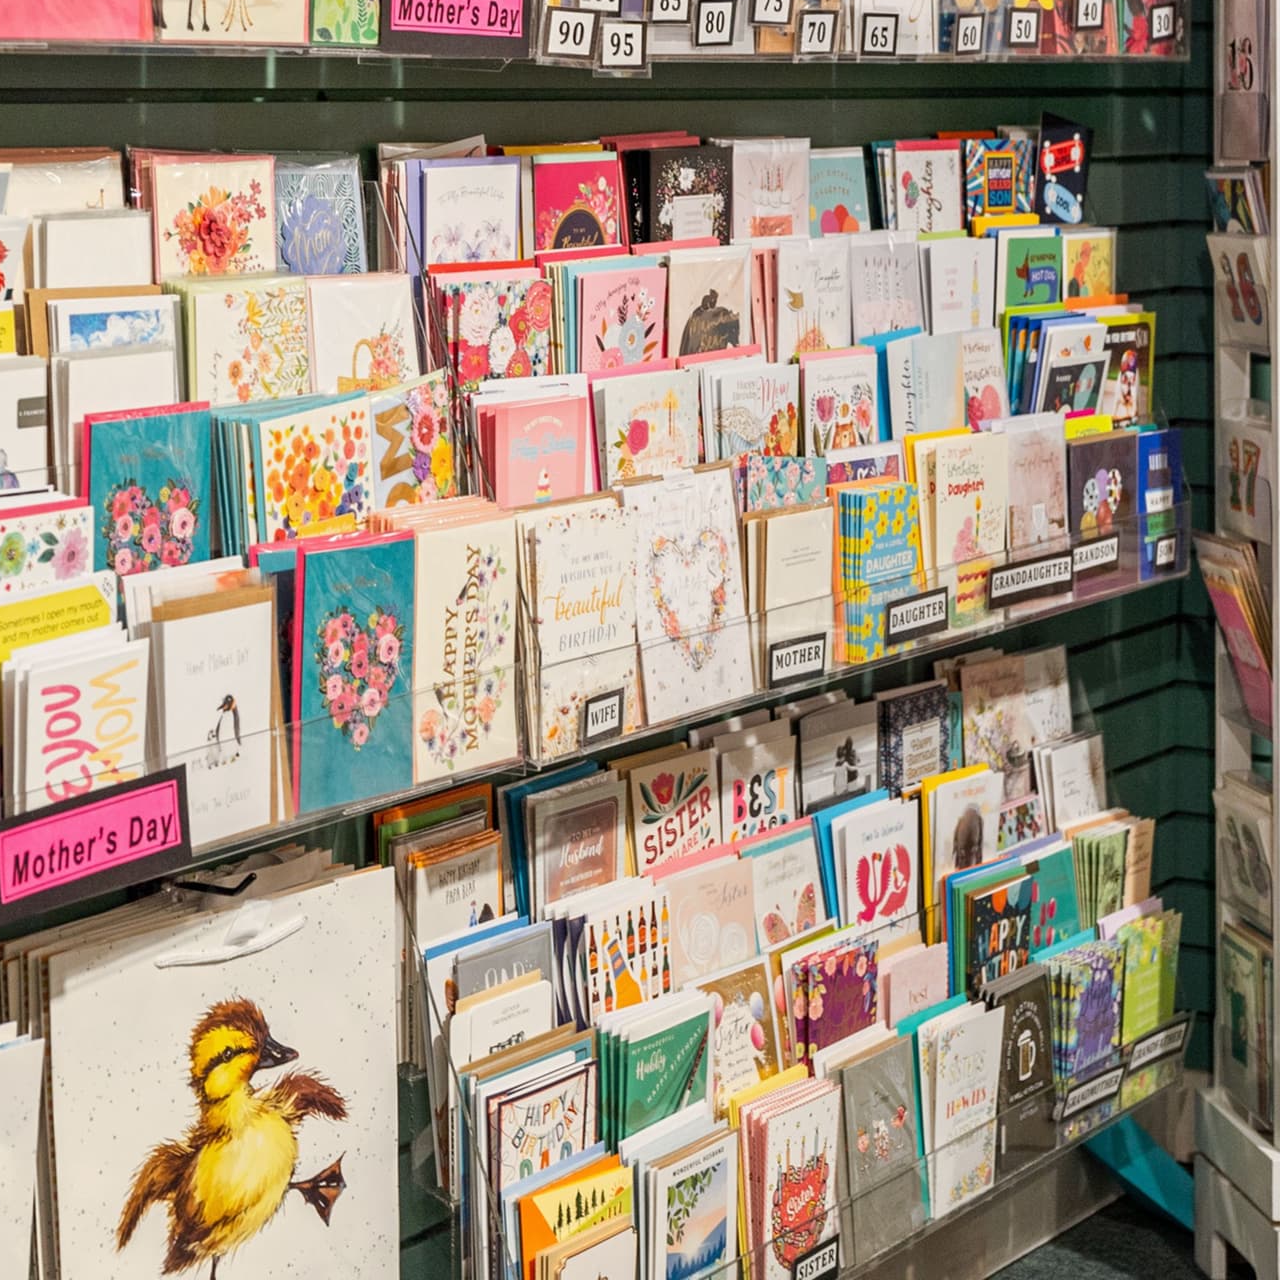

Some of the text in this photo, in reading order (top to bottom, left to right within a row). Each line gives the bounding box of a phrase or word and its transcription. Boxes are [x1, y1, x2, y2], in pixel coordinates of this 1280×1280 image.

[487, 1, 519, 32] Day
[706, 11, 725, 33] 80
[1083, 1, 1097, 20] 40
[1157, 14, 1169, 32] 30
[558, 21, 585, 45] 90
[809, 22, 826, 43] 70
[870, 27, 888, 47] 65
[962, 26, 976, 45] 60
[1016, 19, 1031, 39] 50
[610, 33, 633, 56] 95
[990, 192, 1010, 204] SON
[1074, 542, 1115, 565] GRANDSON
[1159, 545, 1173, 558] SON
[994, 563, 1069, 590] GRANDDAUGHTER
[46, 610, 62, 626] open
[65, 608, 80, 622] my
[80, 600, 104, 615] mouth
[543, 578, 622, 623] beautiful
[892, 602, 945, 628] DAUGHTER
[2, 614, 100, 646] and my mother comes out
[558, 625, 618, 651] BIRTHDAY
[441, 607, 458, 700] HAPPY
[464, 544, 483, 751] MOTHER'S DAY
[775, 645, 821, 668] MOTHER
[590, 705, 617, 726] WIFE
[732, 767, 789, 823] BEST
[644, 784, 712, 865] SISTER
[12, 812, 172, 886] Mother's Day
[560, 836, 604, 868] Husband
[978, 914, 1027, 960] HAPPY
[635, 1049, 667, 1080] Hubby
[524, 1093, 567, 1126] HAPPY
[512, 1106, 580, 1150] BIRTHDAY
[799, 1248, 835, 1280] SISTER
